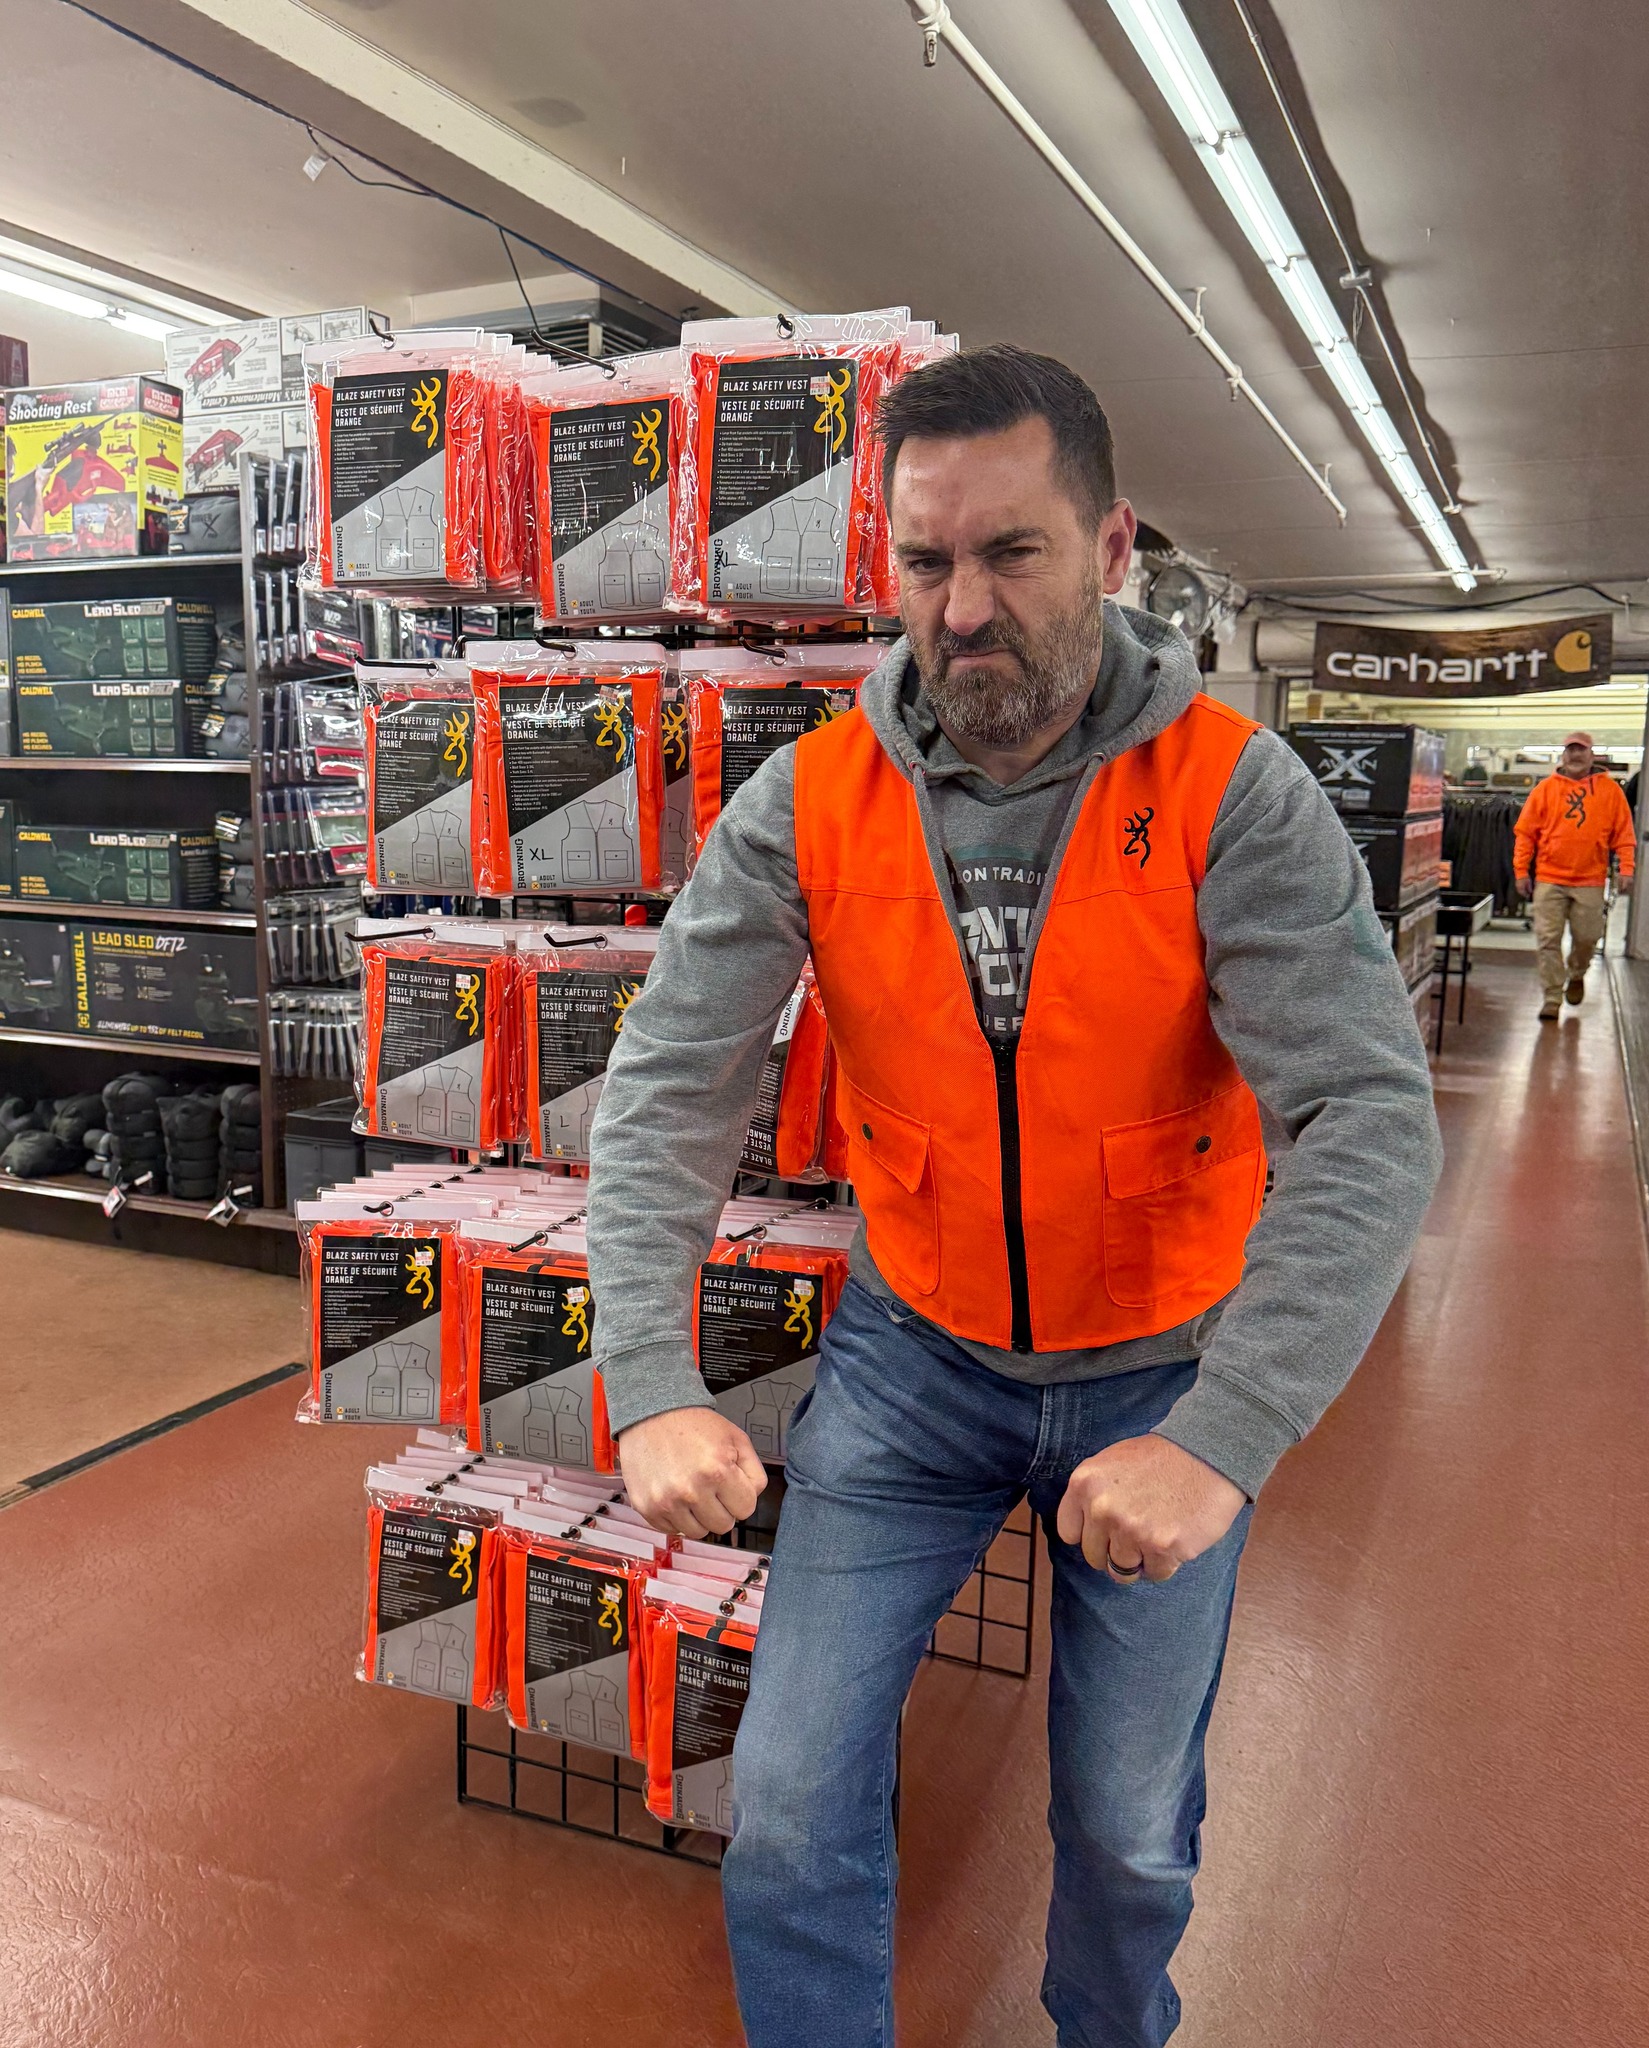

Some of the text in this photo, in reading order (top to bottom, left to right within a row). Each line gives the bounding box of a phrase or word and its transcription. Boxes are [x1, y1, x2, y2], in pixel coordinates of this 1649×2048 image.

[723, 381, 749, 392] BLAZE
[752, 380, 784, 391] SAFETY
[786, 379, 808, 390] VEST
[202, 392, 282, 408] Maintenance Center
[337, 388, 405, 401] BLAZE SAFETY VEST
[9, 403, 62, 421] Shooting
[64, 401, 92, 415] Rest
[336, 403, 403, 417] VESTE DE SÉCURITÉ
[722, 398, 805, 411] VESTE DE SÉCURITÉ
[335, 417, 362, 427] ORANGE
[721, 412, 753, 422] ORANGE
[554, 421, 626, 436] BLAZE SAFETY VEST
[554, 435, 624, 453] VESTE DE SÉCURITÉ
[554, 452, 581, 462] ORANGE
[337, 526, 345, 577] BROWNING
[557, 563, 568, 615] BROWNING
[12, 608, 45, 618] CALDWELL
[1326, 648, 1547, 683] carhartt
[20, 686, 53, 695] CALDWELL
[506, 702, 585, 712] BLAZE SFET VEST
[728, 706, 807, 715] BLAZE SAFETY VEST
[401, 716, 423, 726] SAFETY
[424, 717, 439, 726] VEST
[506, 720, 531, 729] VESTE
[727, 722, 805, 732] VESTE DE SÉCURITÉ
[379, 731, 438, 741] VESTE DE SÉCURITÉ
[508, 731, 538, 739] ORANGE
[727, 733, 757, 742] ORANGE
[379, 740, 402, 749] ORANGE
[19, 832, 52, 842] CALDWELL
[530, 848, 554, 861] XL
[515, 839, 526, 889] BROWNING
[92, 932, 122, 946] LEAD
[124, 934, 154, 949] SLED
[74, 931, 88, 1011] CALDWELL
[389, 972, 449, 986] BLAZE SAFETY VEST
[389, 987, 448, 1001] VESTE DE SÉCURITÉ
[541, 987, 607, 998] BLAZE SAFETY VEST
[389, 995, 412, 1004] ORANGE
[541, 1003, 606, 1013] VESTE DE SÉCURITÉ
[542, 1012, 567, 1020] ORANGE
[779, 997, 793, 1036] WNING
[561, 1116, 569, 1127] L
[543, 1109, 553, 1154] BROWNING
[750, 1138, 772, 1152] VESTE
[750, 1151, 772, 1166] BLAZE
[326, 1252, 348, 1260] BLAZE
[352, 1252, 378, 1260] SAFETY
[326, 1266, 397, 1275] VESTE DE SÉCURITÉ
[487, 1283, 555, 1298] BLAZE SAFETY VEST
[704, 1279, 778, 1295] BLAZE SAFETY VEST
[486, 1299, 554, 1314] VESTE DE SÉCURITÉ
[704, 1295, 775, 1310] VESTE DE SÉCURITÉ
[486, 1309, 512, 1318] ORANGE
[704, 1304, 731, 1315] ORANGE
[325, 1373, 333, 1419] BROWNING
[386, 1525, 446, 1543] BLAZE SAFETY VEST
[384, 1540, 403, 1550] VESTE
[404, 1543, 412, 1552] DE
[384, 1548, 406, 1559] ORANGE
[530, 1570, 592, 1592] BLAZE SAFETY VEST
[529, 1585, 549, 1597] VESTE
[552, 1590, 559, 1599] DE
[529, 1593, 554, 1605] ORANGE
[680, 1649, 749, 1675] BLAZE SAFETY VEST
[679, 1674, 705, 1688] ORANGE
[680, 1664, 748, 1691] VESTE DE SÉCURITÉ
